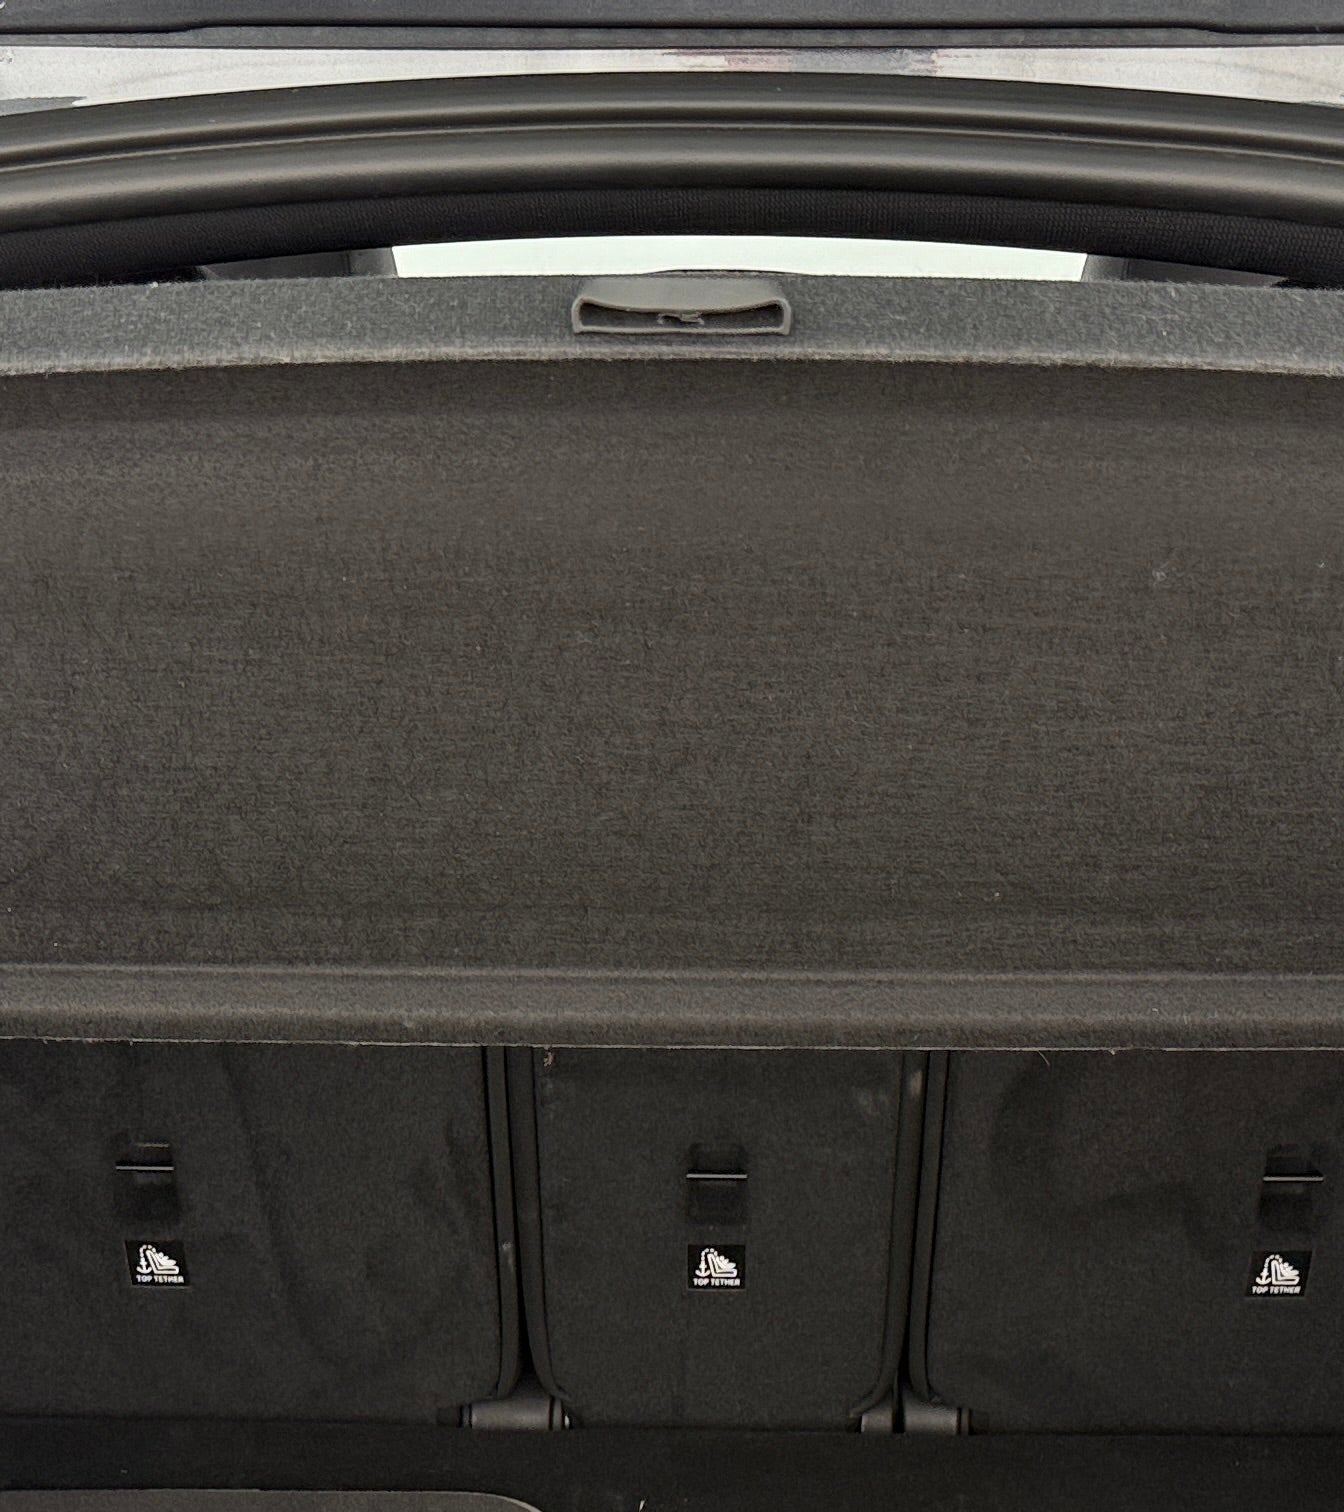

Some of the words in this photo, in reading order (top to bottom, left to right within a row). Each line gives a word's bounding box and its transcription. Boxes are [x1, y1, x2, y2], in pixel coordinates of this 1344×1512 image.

[136, 1274, 153, 1283] TOP
[693, 1277, 709, 1286] TOP
[710, 1277, 741, 1286] TETHER
[1252, 1285, 1269, 1295] TOP
